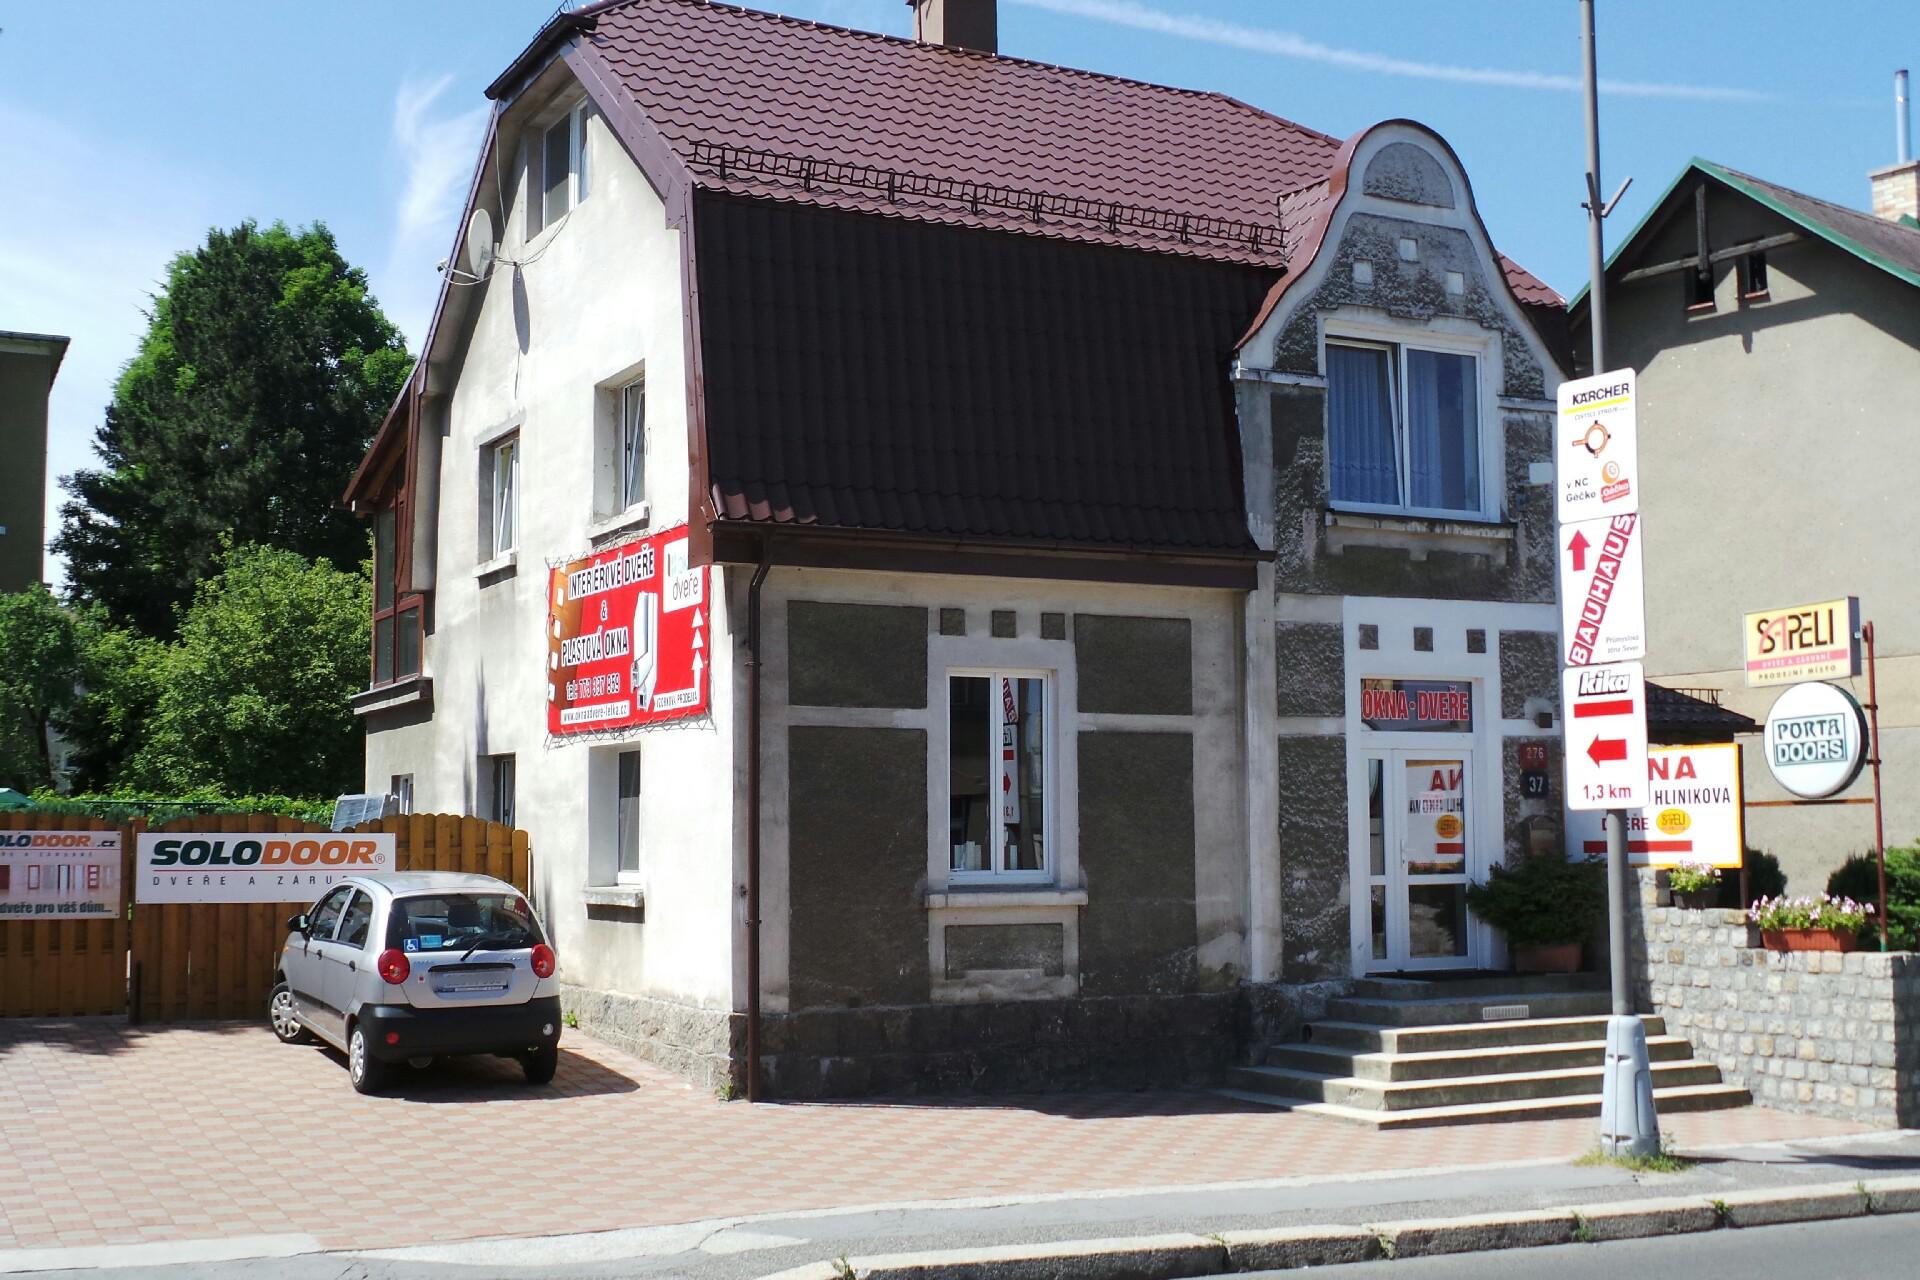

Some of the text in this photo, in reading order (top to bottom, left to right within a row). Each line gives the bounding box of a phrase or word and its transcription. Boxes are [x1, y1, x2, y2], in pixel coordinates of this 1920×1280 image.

[1574, 478, 1588, 487] NC
[569, 555, 621, 598] INTERIÉROVÉ
[625, 545, 653, 583] DVEŘE
[1570, 514, 1635, 665] BAUHAUS
[602, 601, 607, 619] &
[1757, 608, 1834, 654] SAPELI
[562, 628, 628, 664] PLASTOVÁ OKNA
[1578, 670, 1631, 697] kika
[1362, 684, 1470, 720] OKNA DVEŘE
[1777, 718, 1840, 740] PORTA
[1776, 739, 1844, 762] DOORS
[1648, 756, 1697, 780] NA
[1529, 776, 1543, 792] 37
[1583, 784, 1632, 801] 1,3 km
[150, 840, 377, 866] SOLODOOR
[152, 874, 348, 886] DVEŘE A ZÁRU
[35, 903, 54, 914] pro
[58, 901, 77, 913] váš
